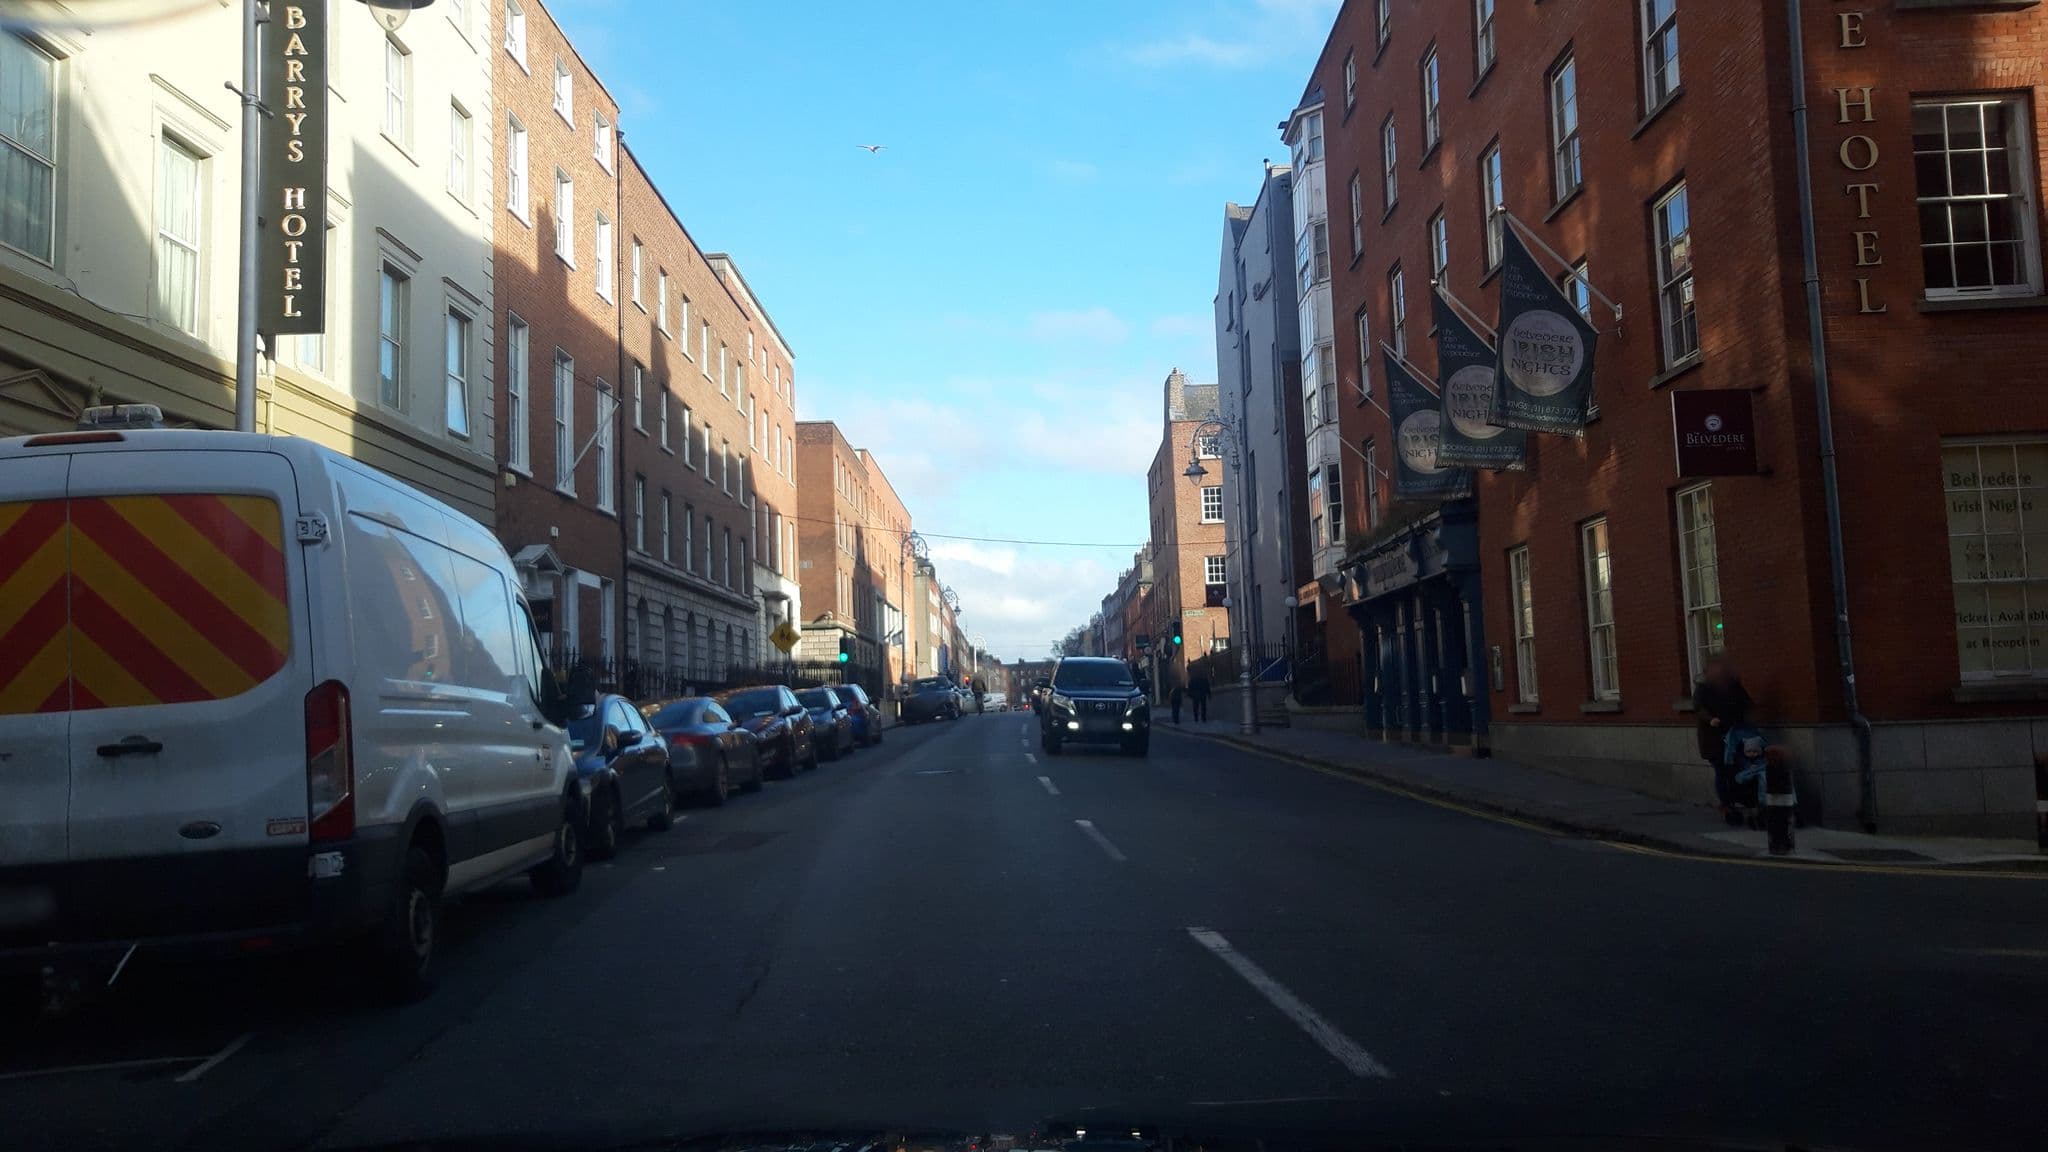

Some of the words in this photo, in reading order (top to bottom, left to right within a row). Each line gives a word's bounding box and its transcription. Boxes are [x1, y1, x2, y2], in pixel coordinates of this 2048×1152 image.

[284, 5, 308, 163] BARRYS
[1834, 86, 1887, 314] HOTEL
[281, 187, 307, 317] HOTEL
[1512, 339, 1576, 363] IRISH
[1511, 358, 1571, 376] NIGHTS
[1451, 393, 1491, 409] IRIS
[1451, 408, 1488, 420] NIGH
[1686, 432, 1745, 445] BELVEDERE
[1405, 448, 1438, 459] NIGH
[1956, 611, 1993, 623] ickets
[1998, 610, 2048, 622] Avaiabl
[1982, 637, 2040, 649] Receptin
